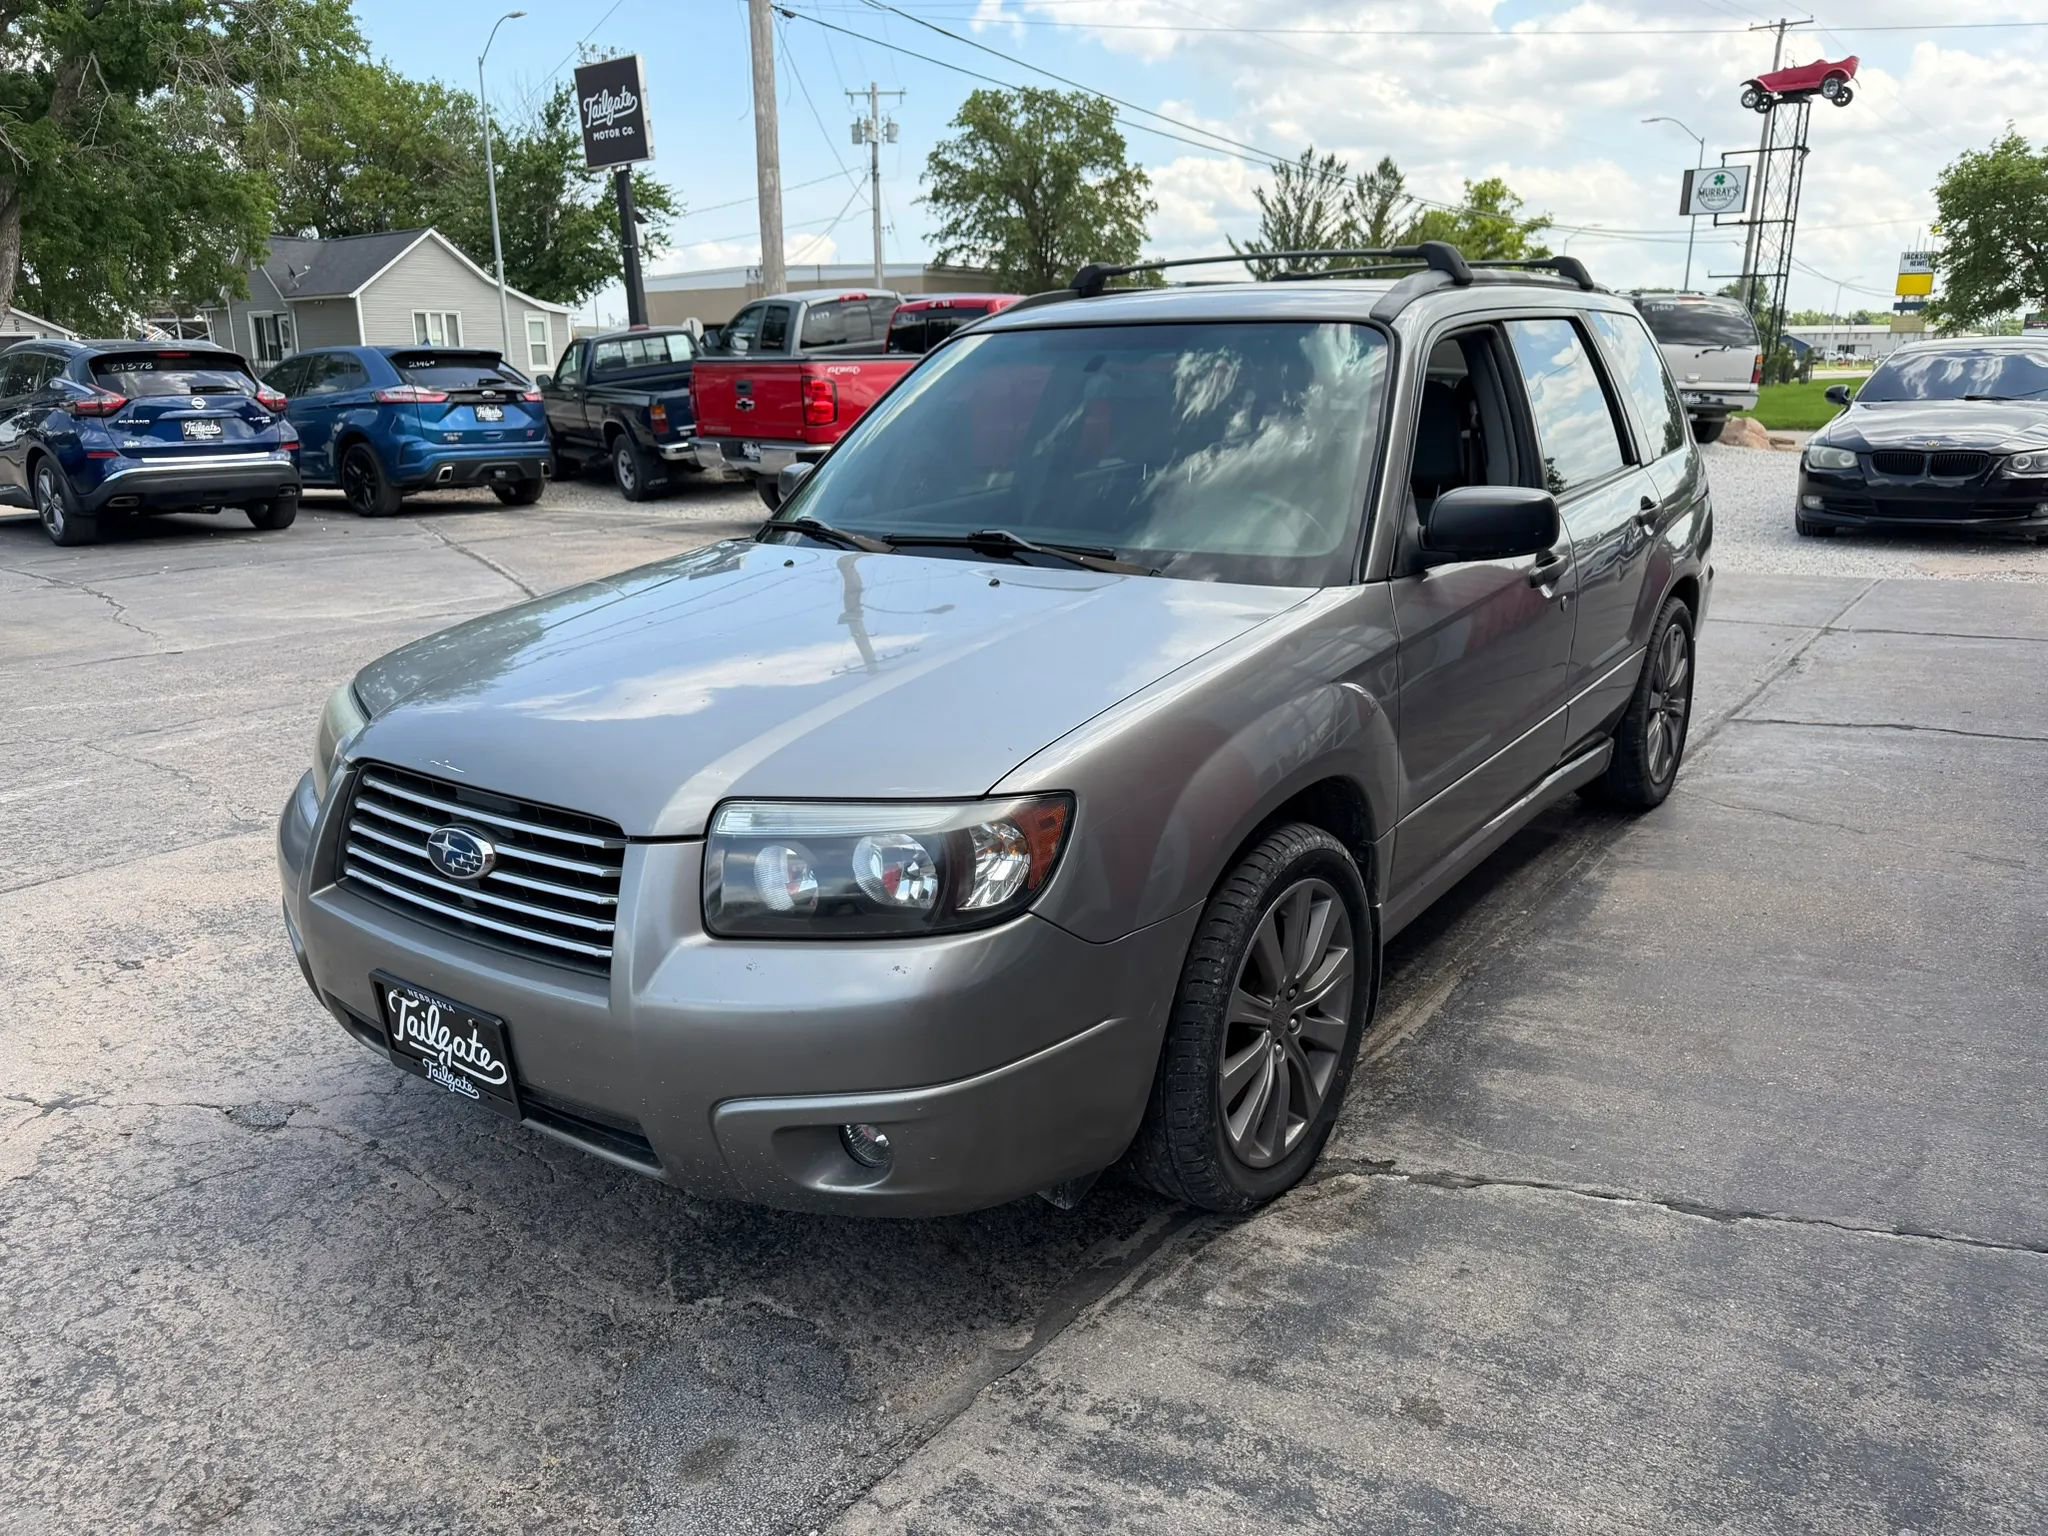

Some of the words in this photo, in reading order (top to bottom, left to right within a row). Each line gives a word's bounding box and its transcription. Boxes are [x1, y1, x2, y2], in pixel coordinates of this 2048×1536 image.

[583, 85, 638, 128] Tailgate
[593, 128, 620, 141] MOTOR
[407, 989, 456, 1014] NEBRASKA
[388, 989, 508, 1085] Tailgate
[422, 1057, 480, 1099] Tailgate
